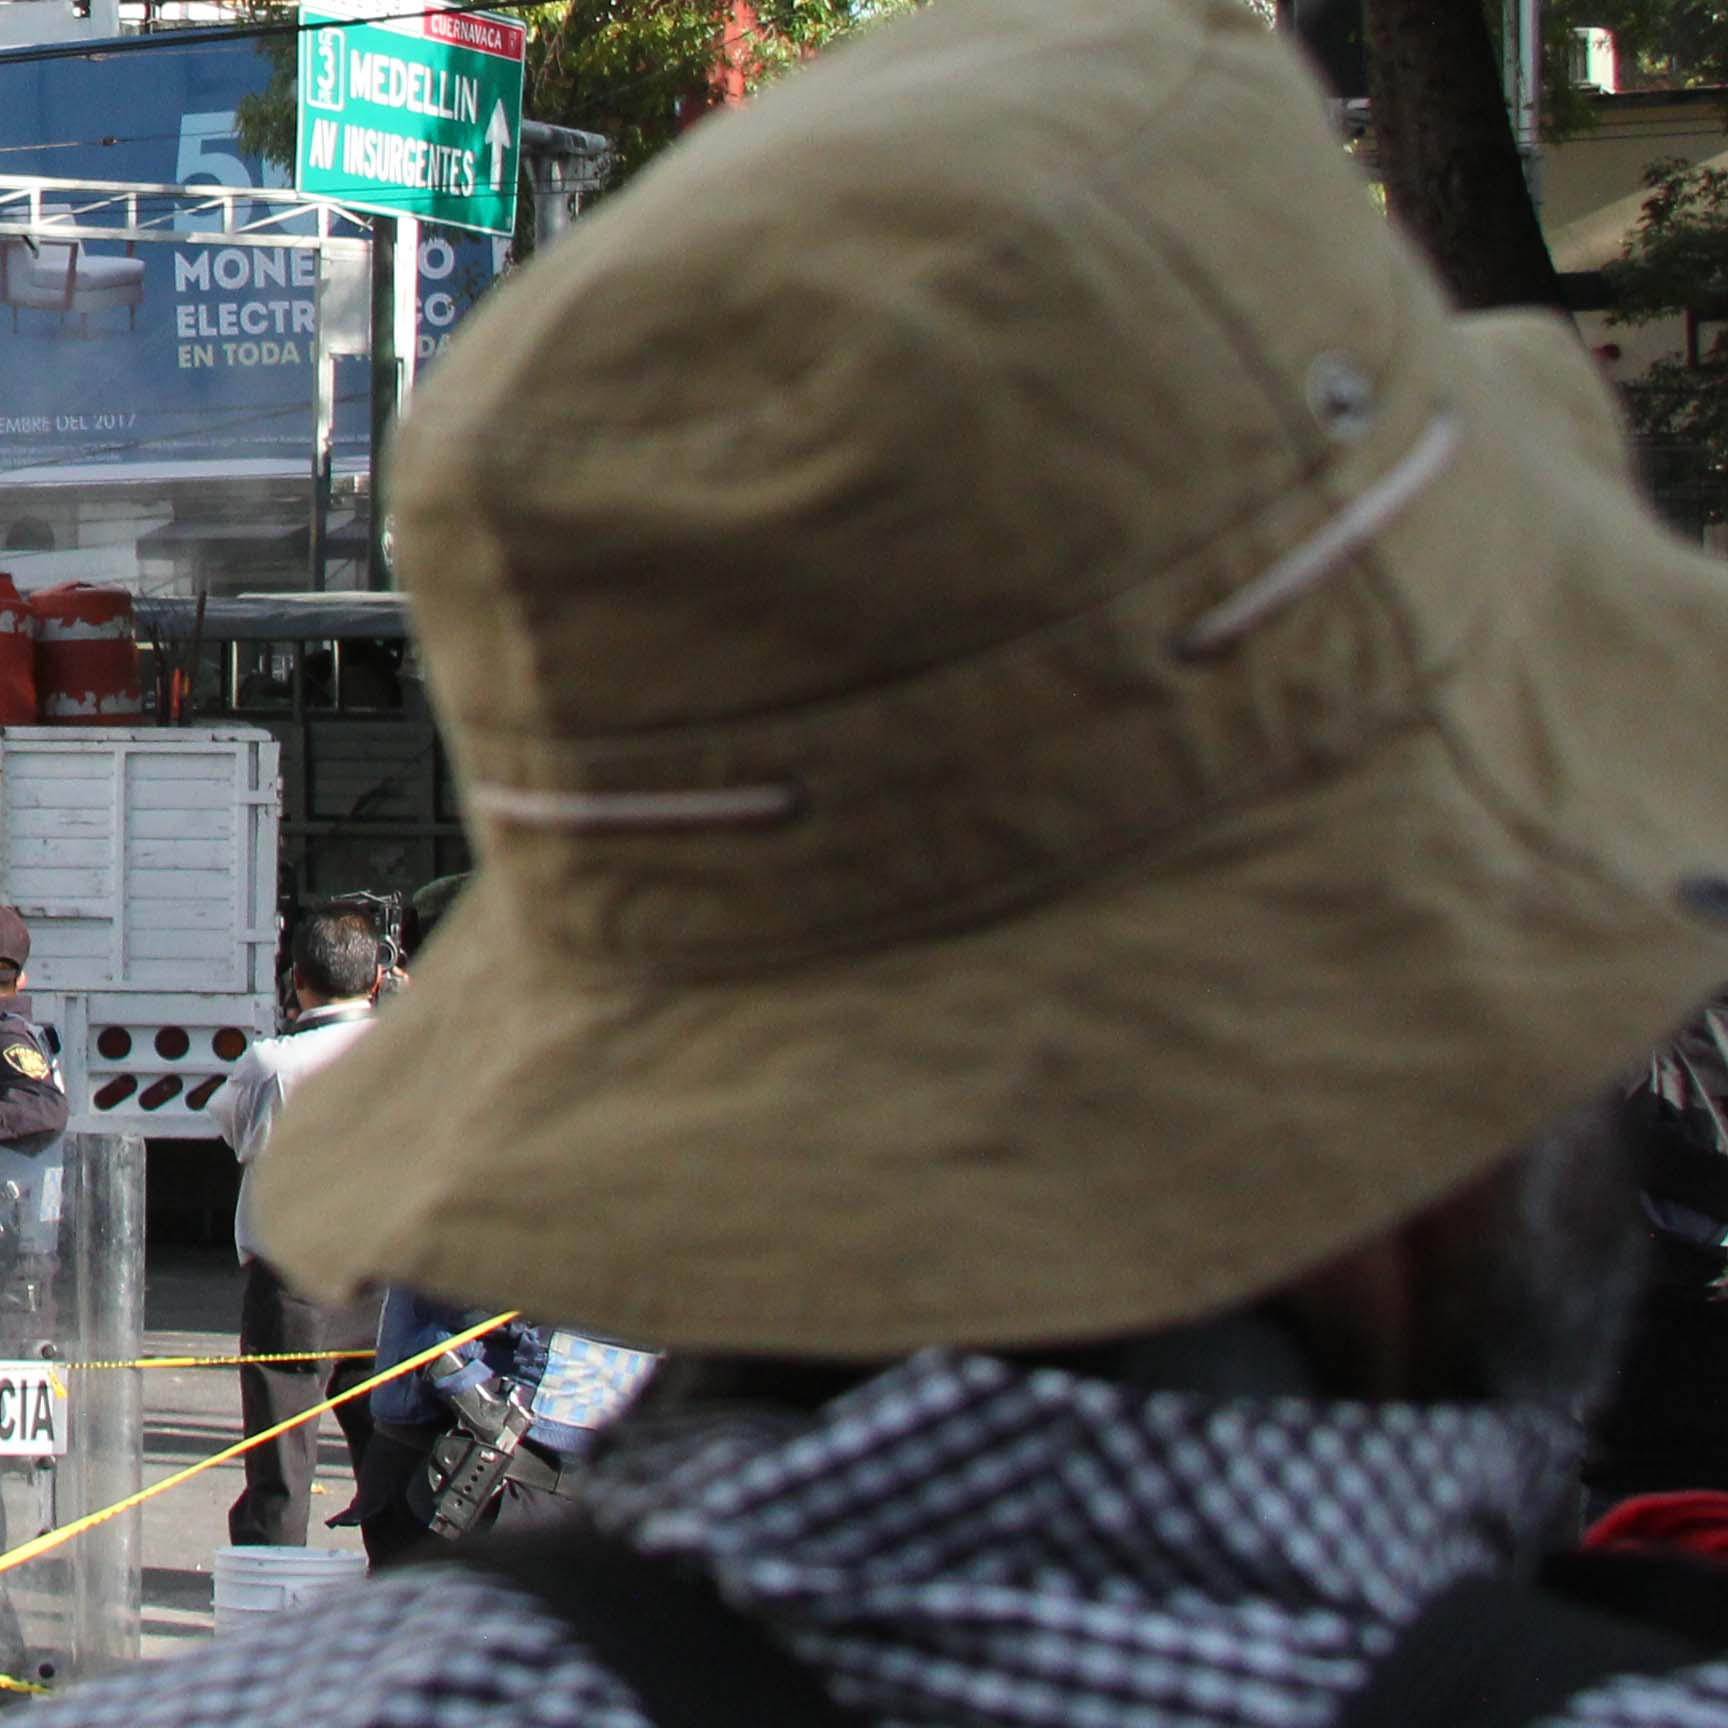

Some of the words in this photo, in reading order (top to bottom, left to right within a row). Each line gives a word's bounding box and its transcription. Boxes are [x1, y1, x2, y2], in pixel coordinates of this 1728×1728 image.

[431, 12, 504, 50] CUERNAVACA
[317, 49, 336, 86] 3
[349, 49, 480, 125] MEDELLIN
[308, 117, 340, 172] AV
[344, 123, 476, 198] INSURGENTES
[177, 344, 214, 369] EN
[223, 341, 301, 367] TODA
[56, 414, 88, 433] DEL
[95, 413, 137, 431] 2017
